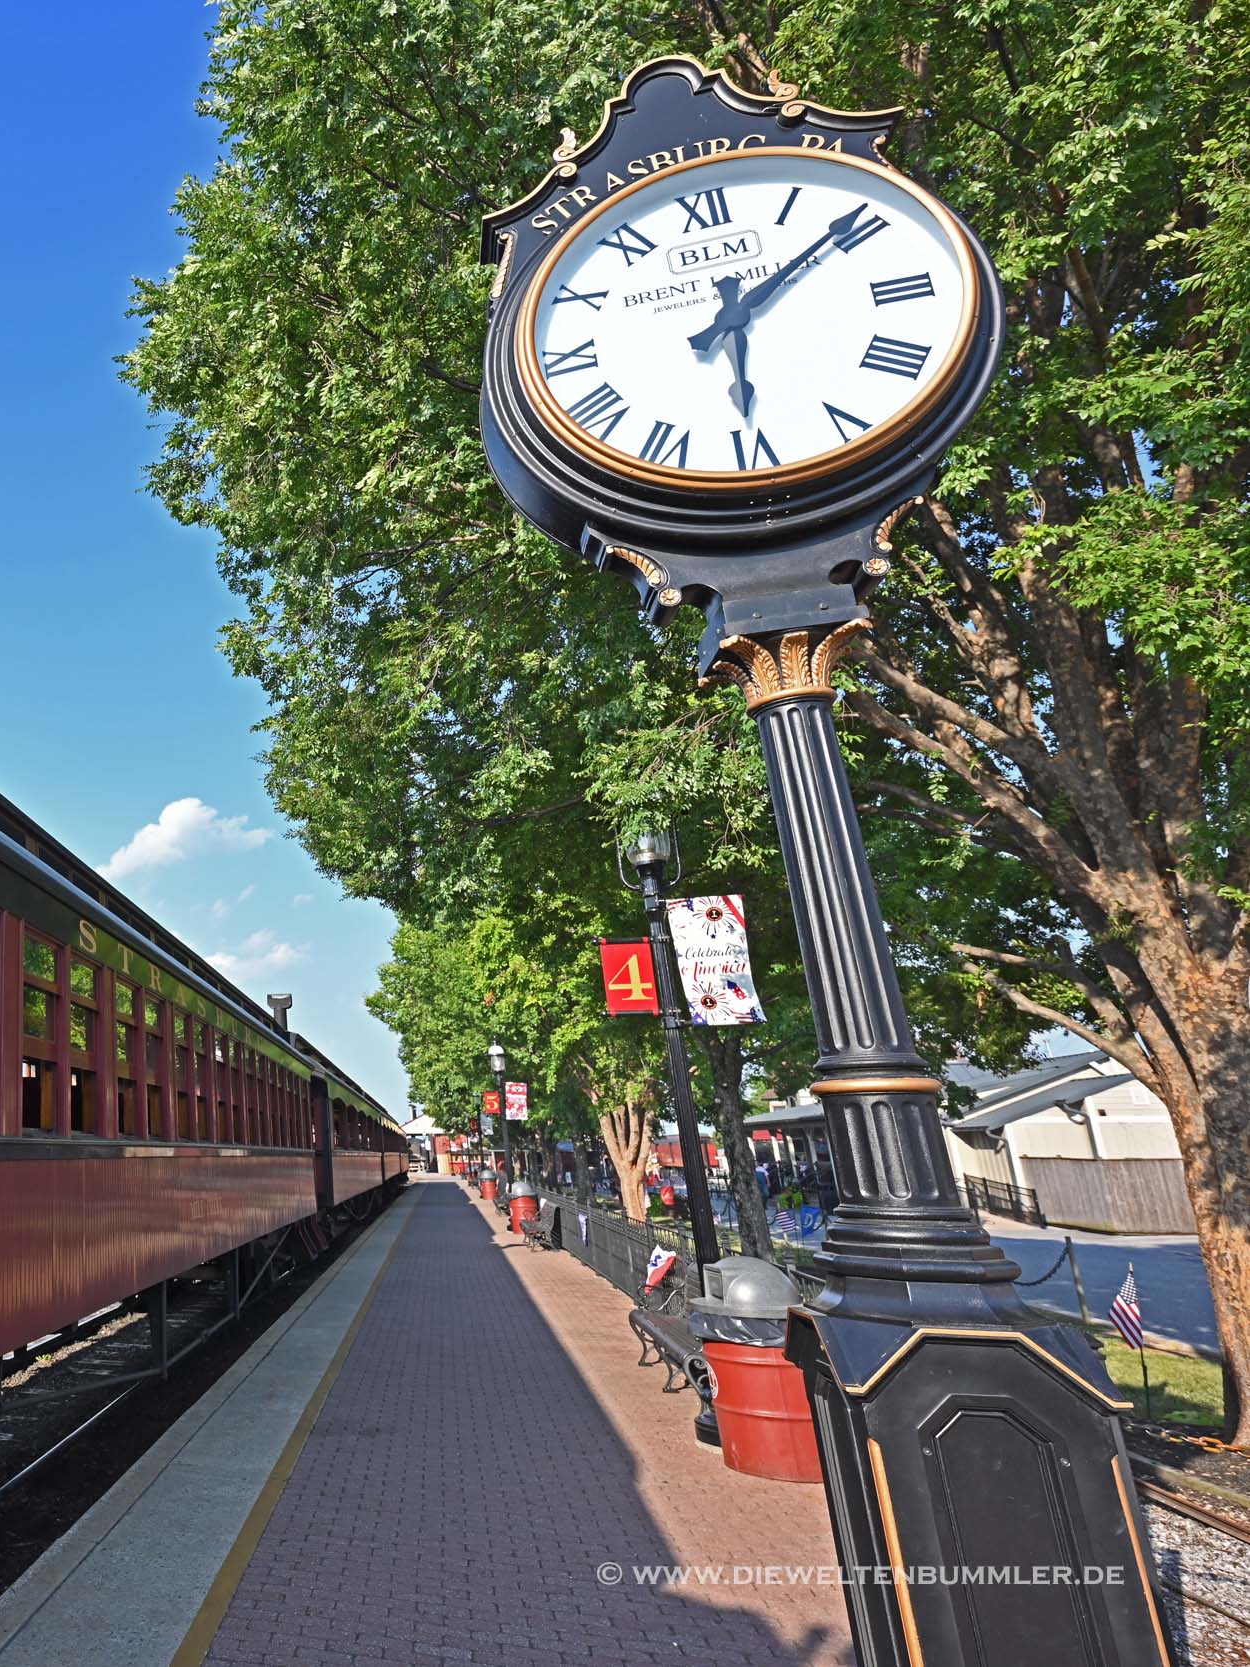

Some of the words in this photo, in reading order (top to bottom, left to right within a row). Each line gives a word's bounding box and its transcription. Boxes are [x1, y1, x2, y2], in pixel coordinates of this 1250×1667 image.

[674, 187, 733, 233] XII
[774, 186, 802, 225] I
[597, 222, 658, 267] XI
[679, 238, 750, 267] BLM
[833, 214, 891, 254] II
[551, 284, 609, 311] X
[623, 279, 700, 308] BRENT
[735, 255, 822, 282] MILLR
[870, 272, 935, 307] III
[653, 296, 707, 314] JEWELERS
[542, 338, 598, 379] IX
[859, 334, 932, 380] IIII
[565, 382, 630, 441] VIII
[822, 401, 873, 443] V
[639, 420, 690, 469] VII
[730, 427, 781, 471] VI
[685, 943, 737, 960] Celebrate
[608, 954, 654, 1001] 4
[486, 1095, 499, 1110] 5
